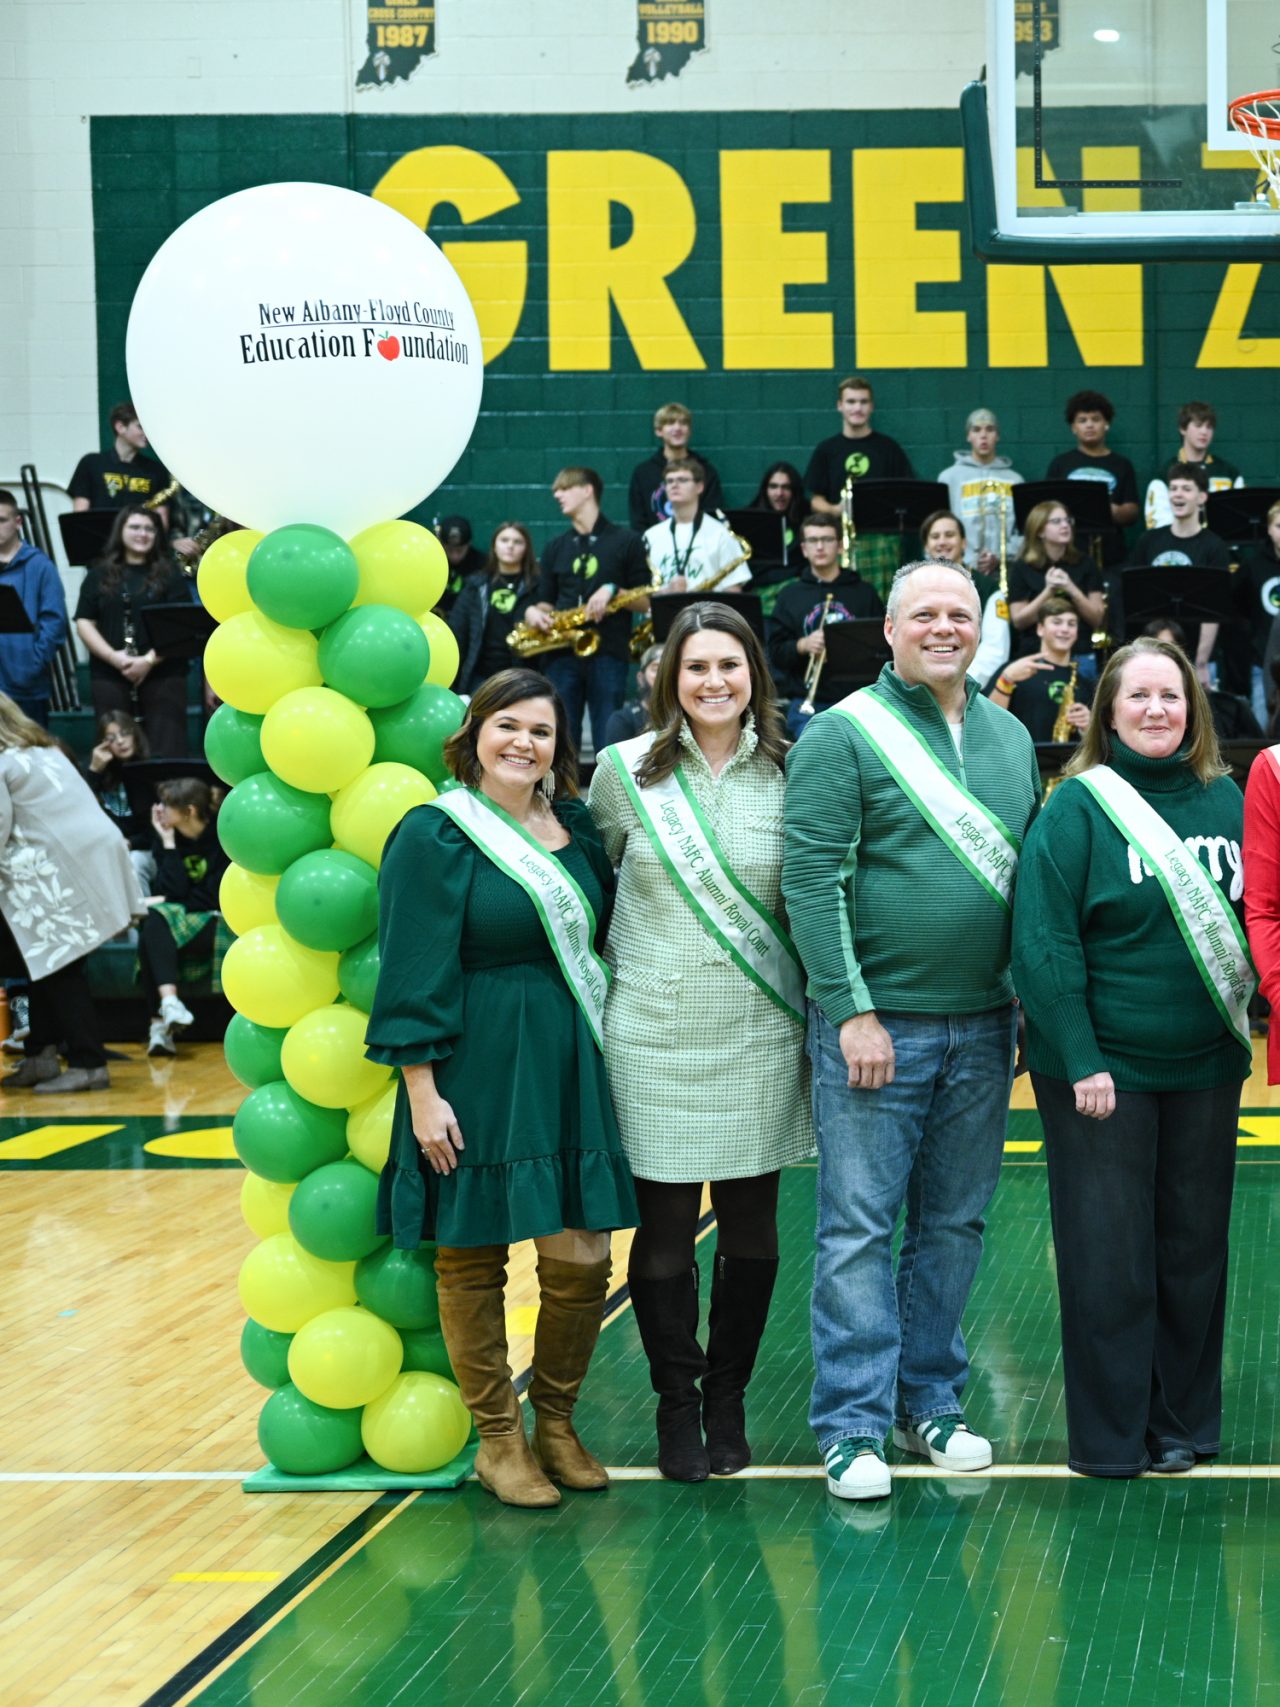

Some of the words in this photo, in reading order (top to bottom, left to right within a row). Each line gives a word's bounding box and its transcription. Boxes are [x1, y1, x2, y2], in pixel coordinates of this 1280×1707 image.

[377, 25, 428, 47] 1987
[647, 21, 698, 44] 1990
[370, 144, 1144, 371] GREEN
[240, 329, 356, 364] Education
[259, 303, 295, 325] New
[302, 299, 411, 323] Albany-Floyd
[413, 302, 455, 330] County
[956, 812, 989, 851] Legacy
[984, 846, 1012, 878] NAFC
[660, 799, 685, 836] Legacy
[677, 835, 705, 869] NAFC
[696, 868, 731, 906] Alumni
[723, 903, 753, 933] Royal
[747, 928, 771, 958] Court
[520, 854, 554, 886] Legacy
[551, 886, 574, 919] NAFC
[564, 919, 584, 958] Alumni
[577, 955, 596, 988] Royal
[1164, 848, 1194, 887] Legacy
[1186, 887, 1212, 921] NAFC
[1202, 920, 1232, 961] Alumni
[1221, 960, 1244, 988] Royal
